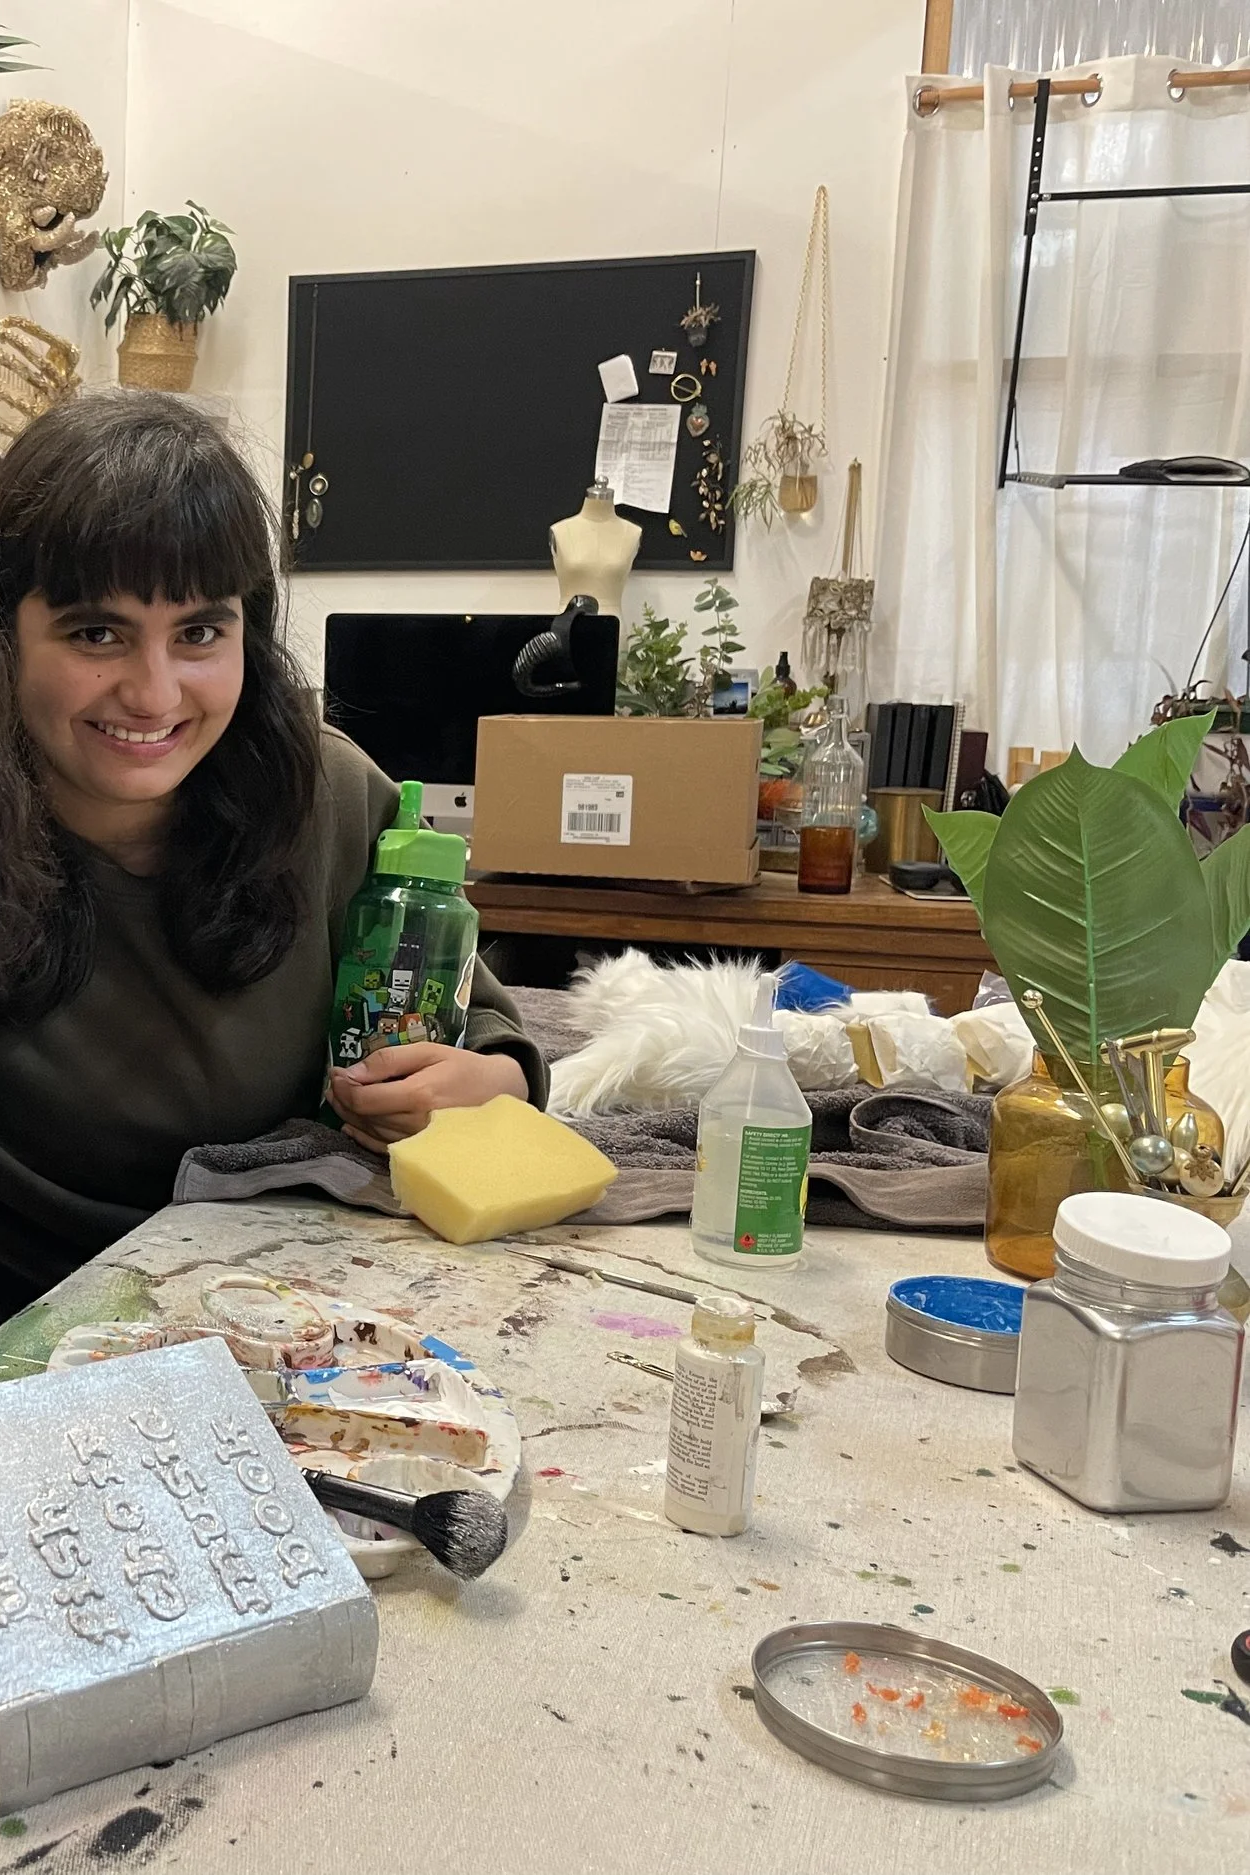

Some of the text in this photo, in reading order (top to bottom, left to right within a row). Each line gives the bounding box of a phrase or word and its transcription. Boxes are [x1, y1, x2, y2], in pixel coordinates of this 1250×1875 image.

[65, 1429, 189, 1622] choir
[128, 1406, 272, 1616] music
[209, 1414, 328, 1590] book
